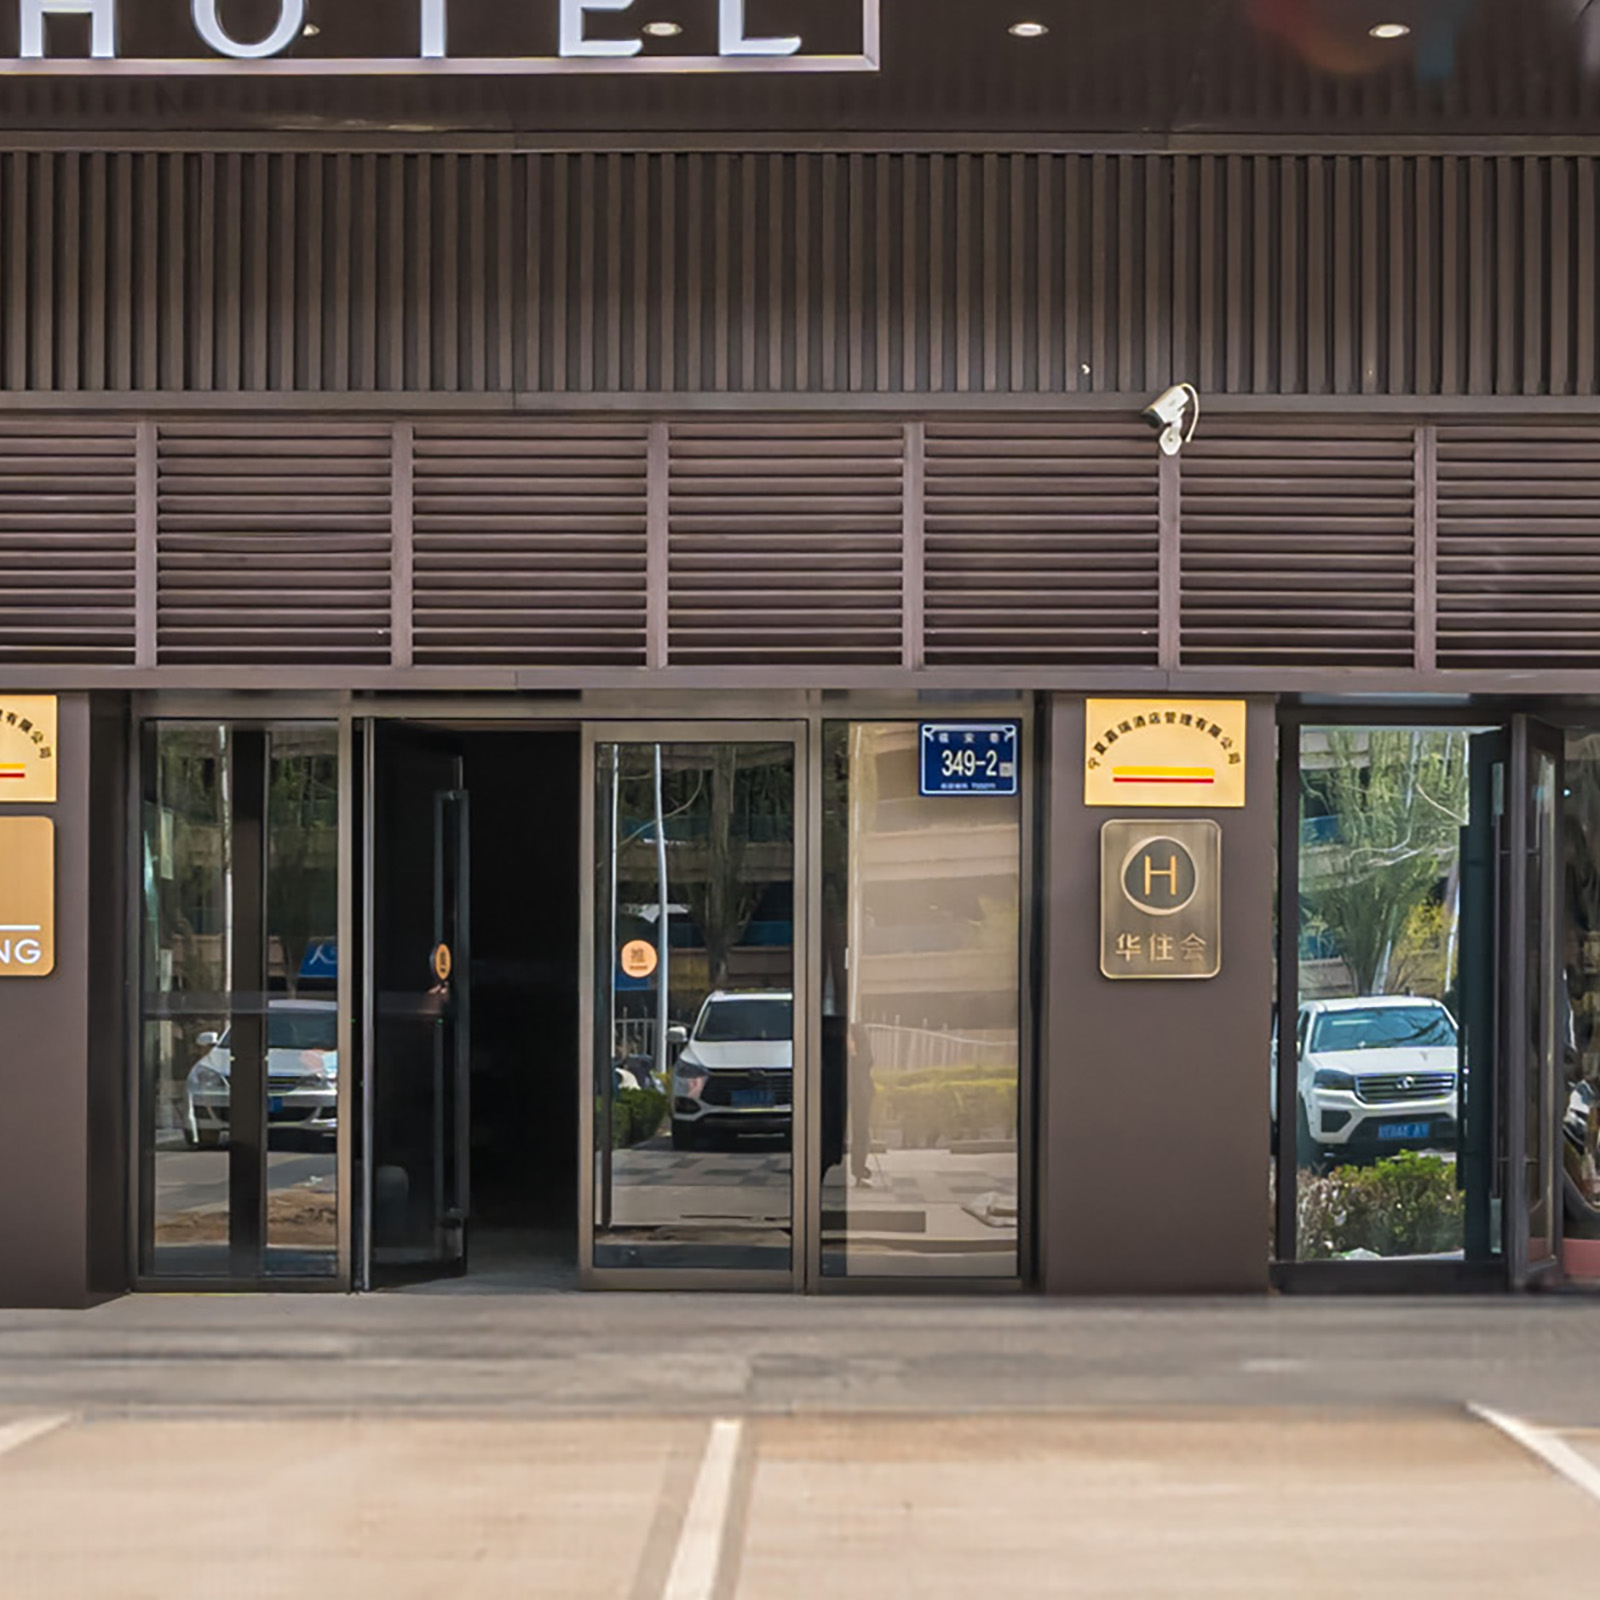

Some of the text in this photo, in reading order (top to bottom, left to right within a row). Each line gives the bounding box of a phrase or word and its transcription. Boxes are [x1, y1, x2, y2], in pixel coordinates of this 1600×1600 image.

[941, 749, 997, 777] 349-2
[1144, 855, 1177, 895] H
[1115, 932, 1206, 963] 华住会
